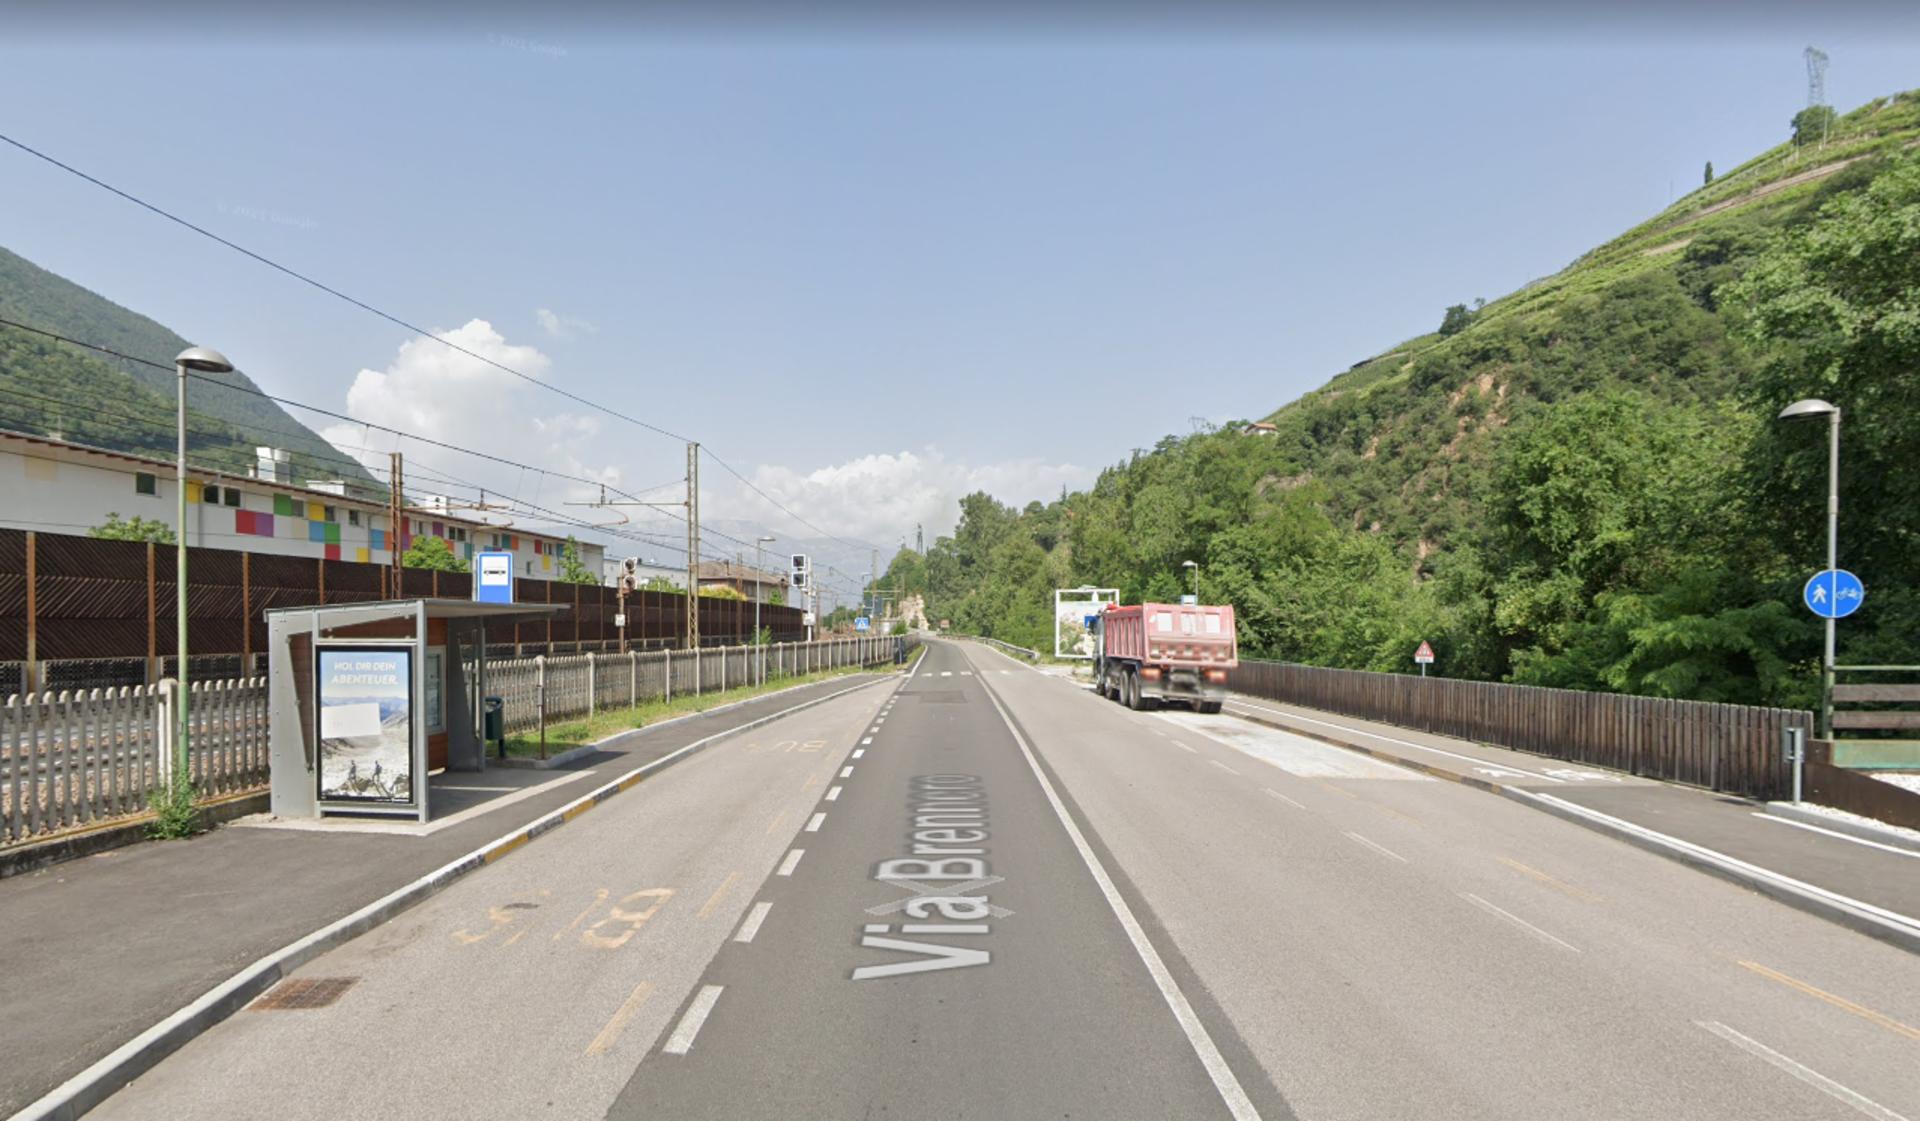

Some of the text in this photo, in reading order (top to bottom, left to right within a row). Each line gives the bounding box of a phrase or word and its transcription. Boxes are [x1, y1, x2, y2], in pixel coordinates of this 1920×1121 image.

[334, 662, 397, 671] HOL DIR DEIN
